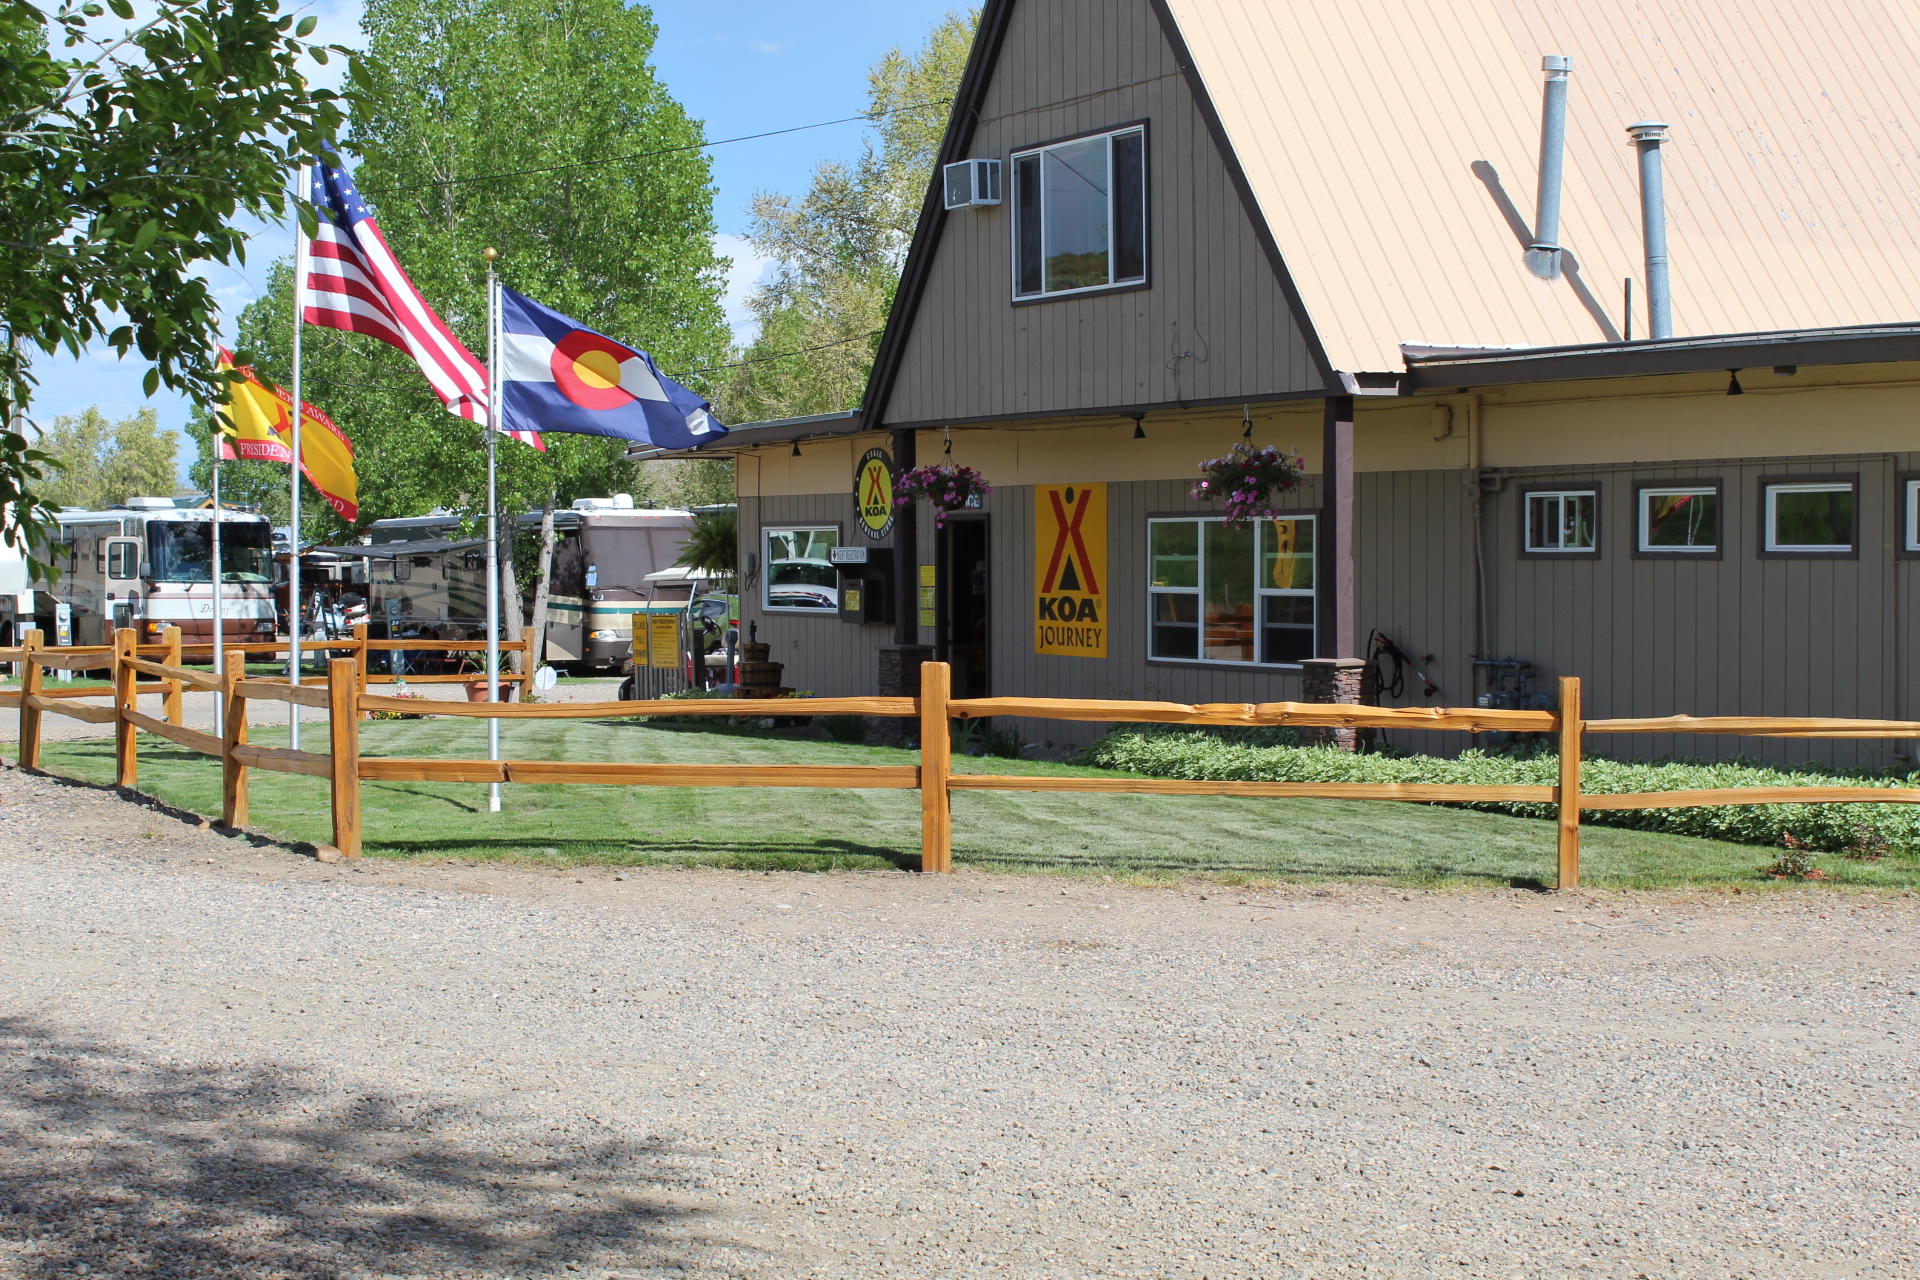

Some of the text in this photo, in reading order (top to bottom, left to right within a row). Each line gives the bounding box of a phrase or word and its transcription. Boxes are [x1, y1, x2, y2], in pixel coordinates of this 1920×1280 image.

[306, 408, 345, 441] AWARD
[240, 443, 293, 460] PRESIDEN
[866, 449, 882, 460] CRAIG
[865, 505, 887, 517] KOA
[859, 516, 894, 539] GENERAL STORE
[1038, 595, 1099, 623] KOA
[633, 621, 646, 630] PLEASE
[635, 635, 644, 644] PULL
[1039, 626, 1102, 649] JOURNEY
